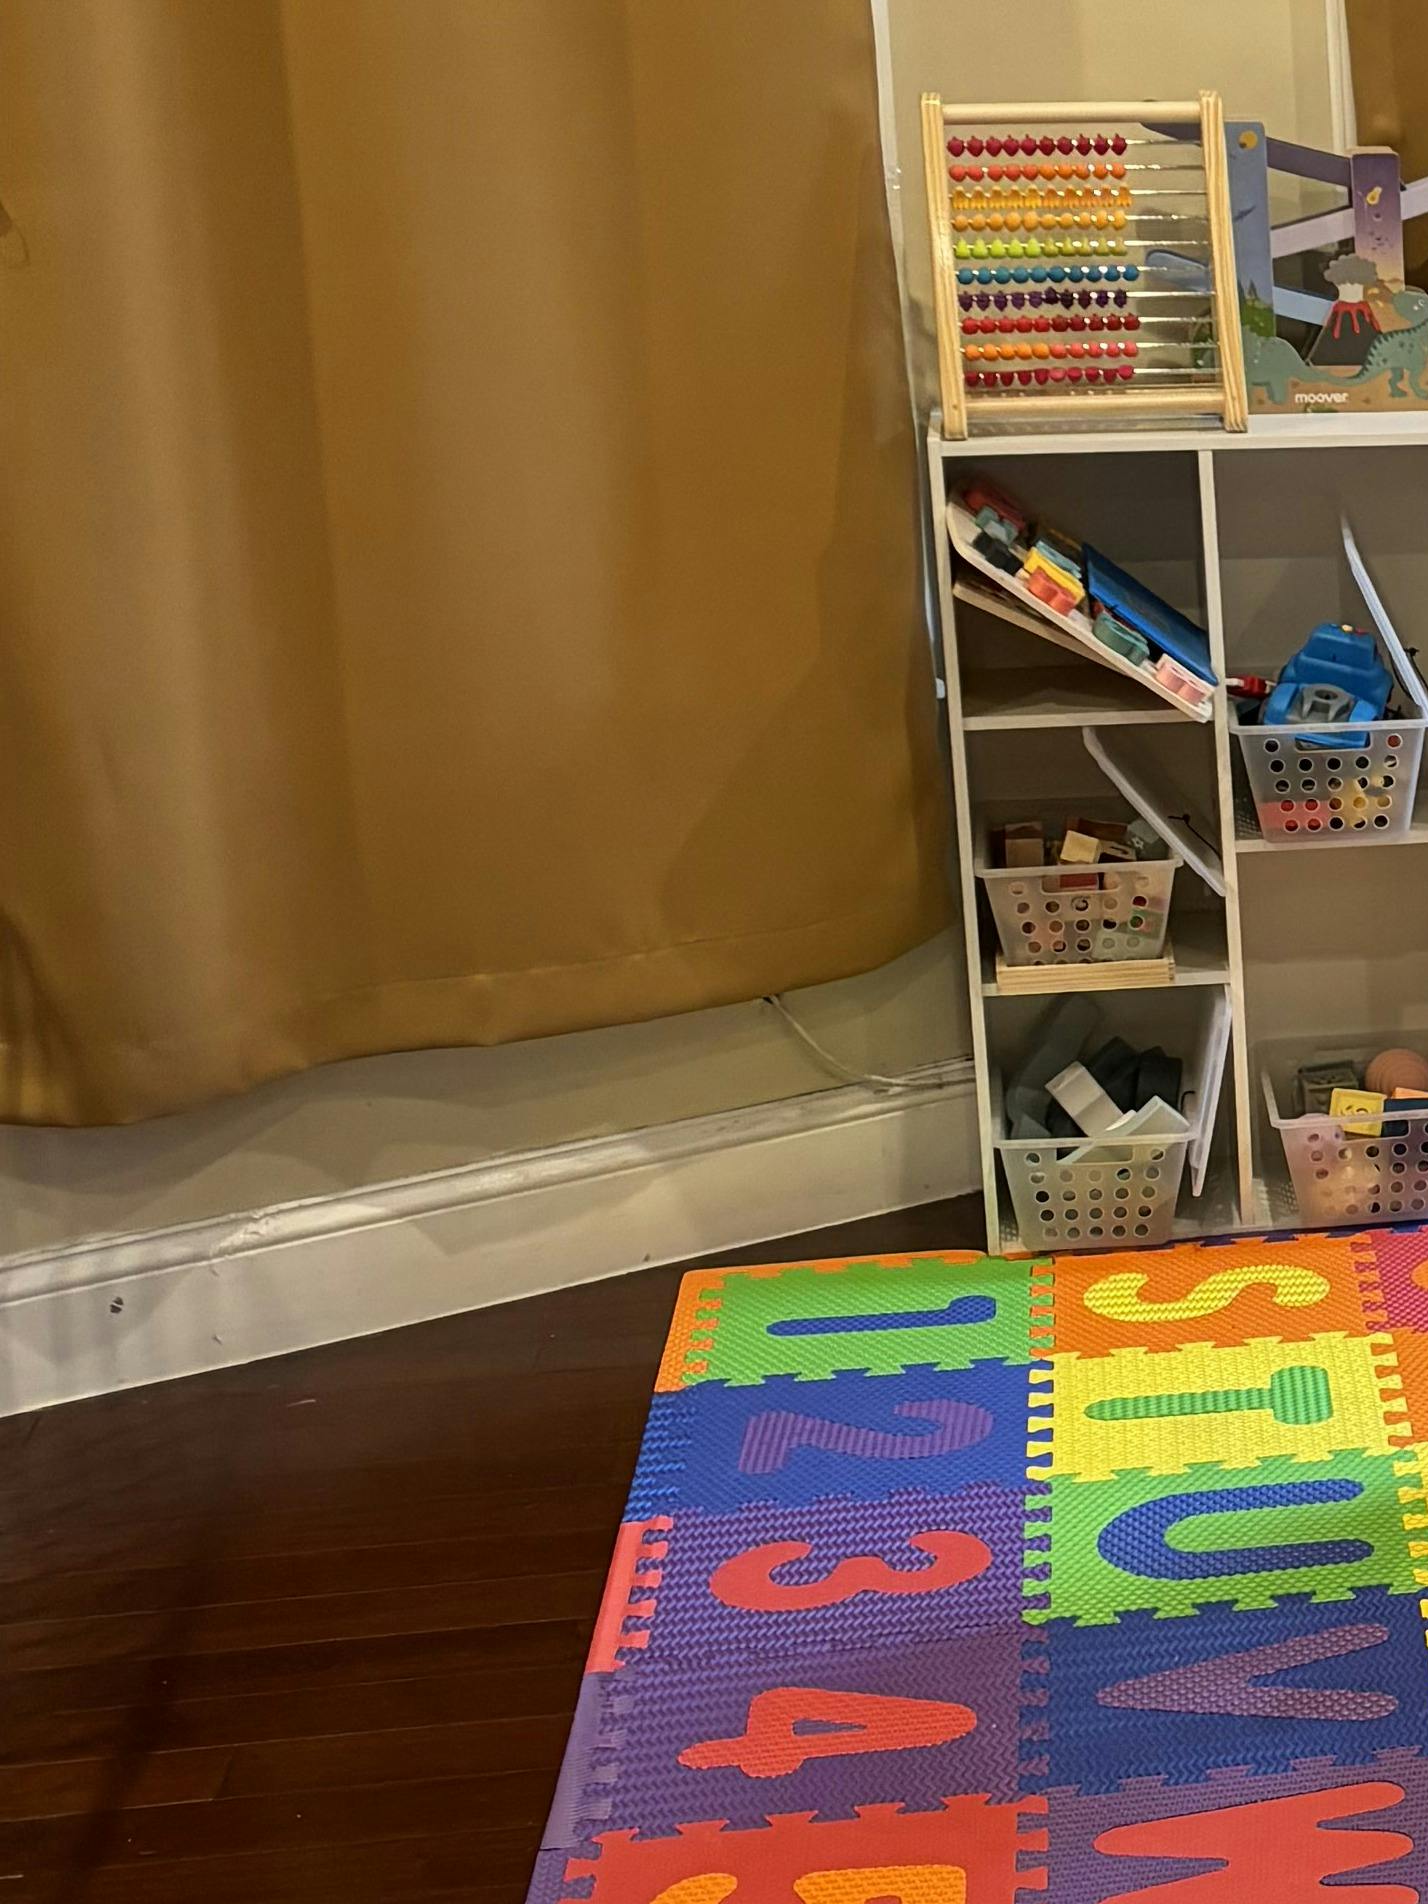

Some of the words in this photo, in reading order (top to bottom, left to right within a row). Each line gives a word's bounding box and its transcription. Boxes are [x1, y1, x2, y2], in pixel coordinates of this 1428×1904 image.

[1294, 391, 1349, 404] moover
[765, 1294, 998, 1337] 1
[1082, 1264, 1331, 1322] S
[1083, 1364, 1335, 1426] T
[738, 1398, 995, 1476] 2
[1096, 1477, 1375, 1583] U
[708, 1529, 993, 1611] 3
[1095, 1623, 1397, 1721] V
[677, 1685, 978, 1779] 4
